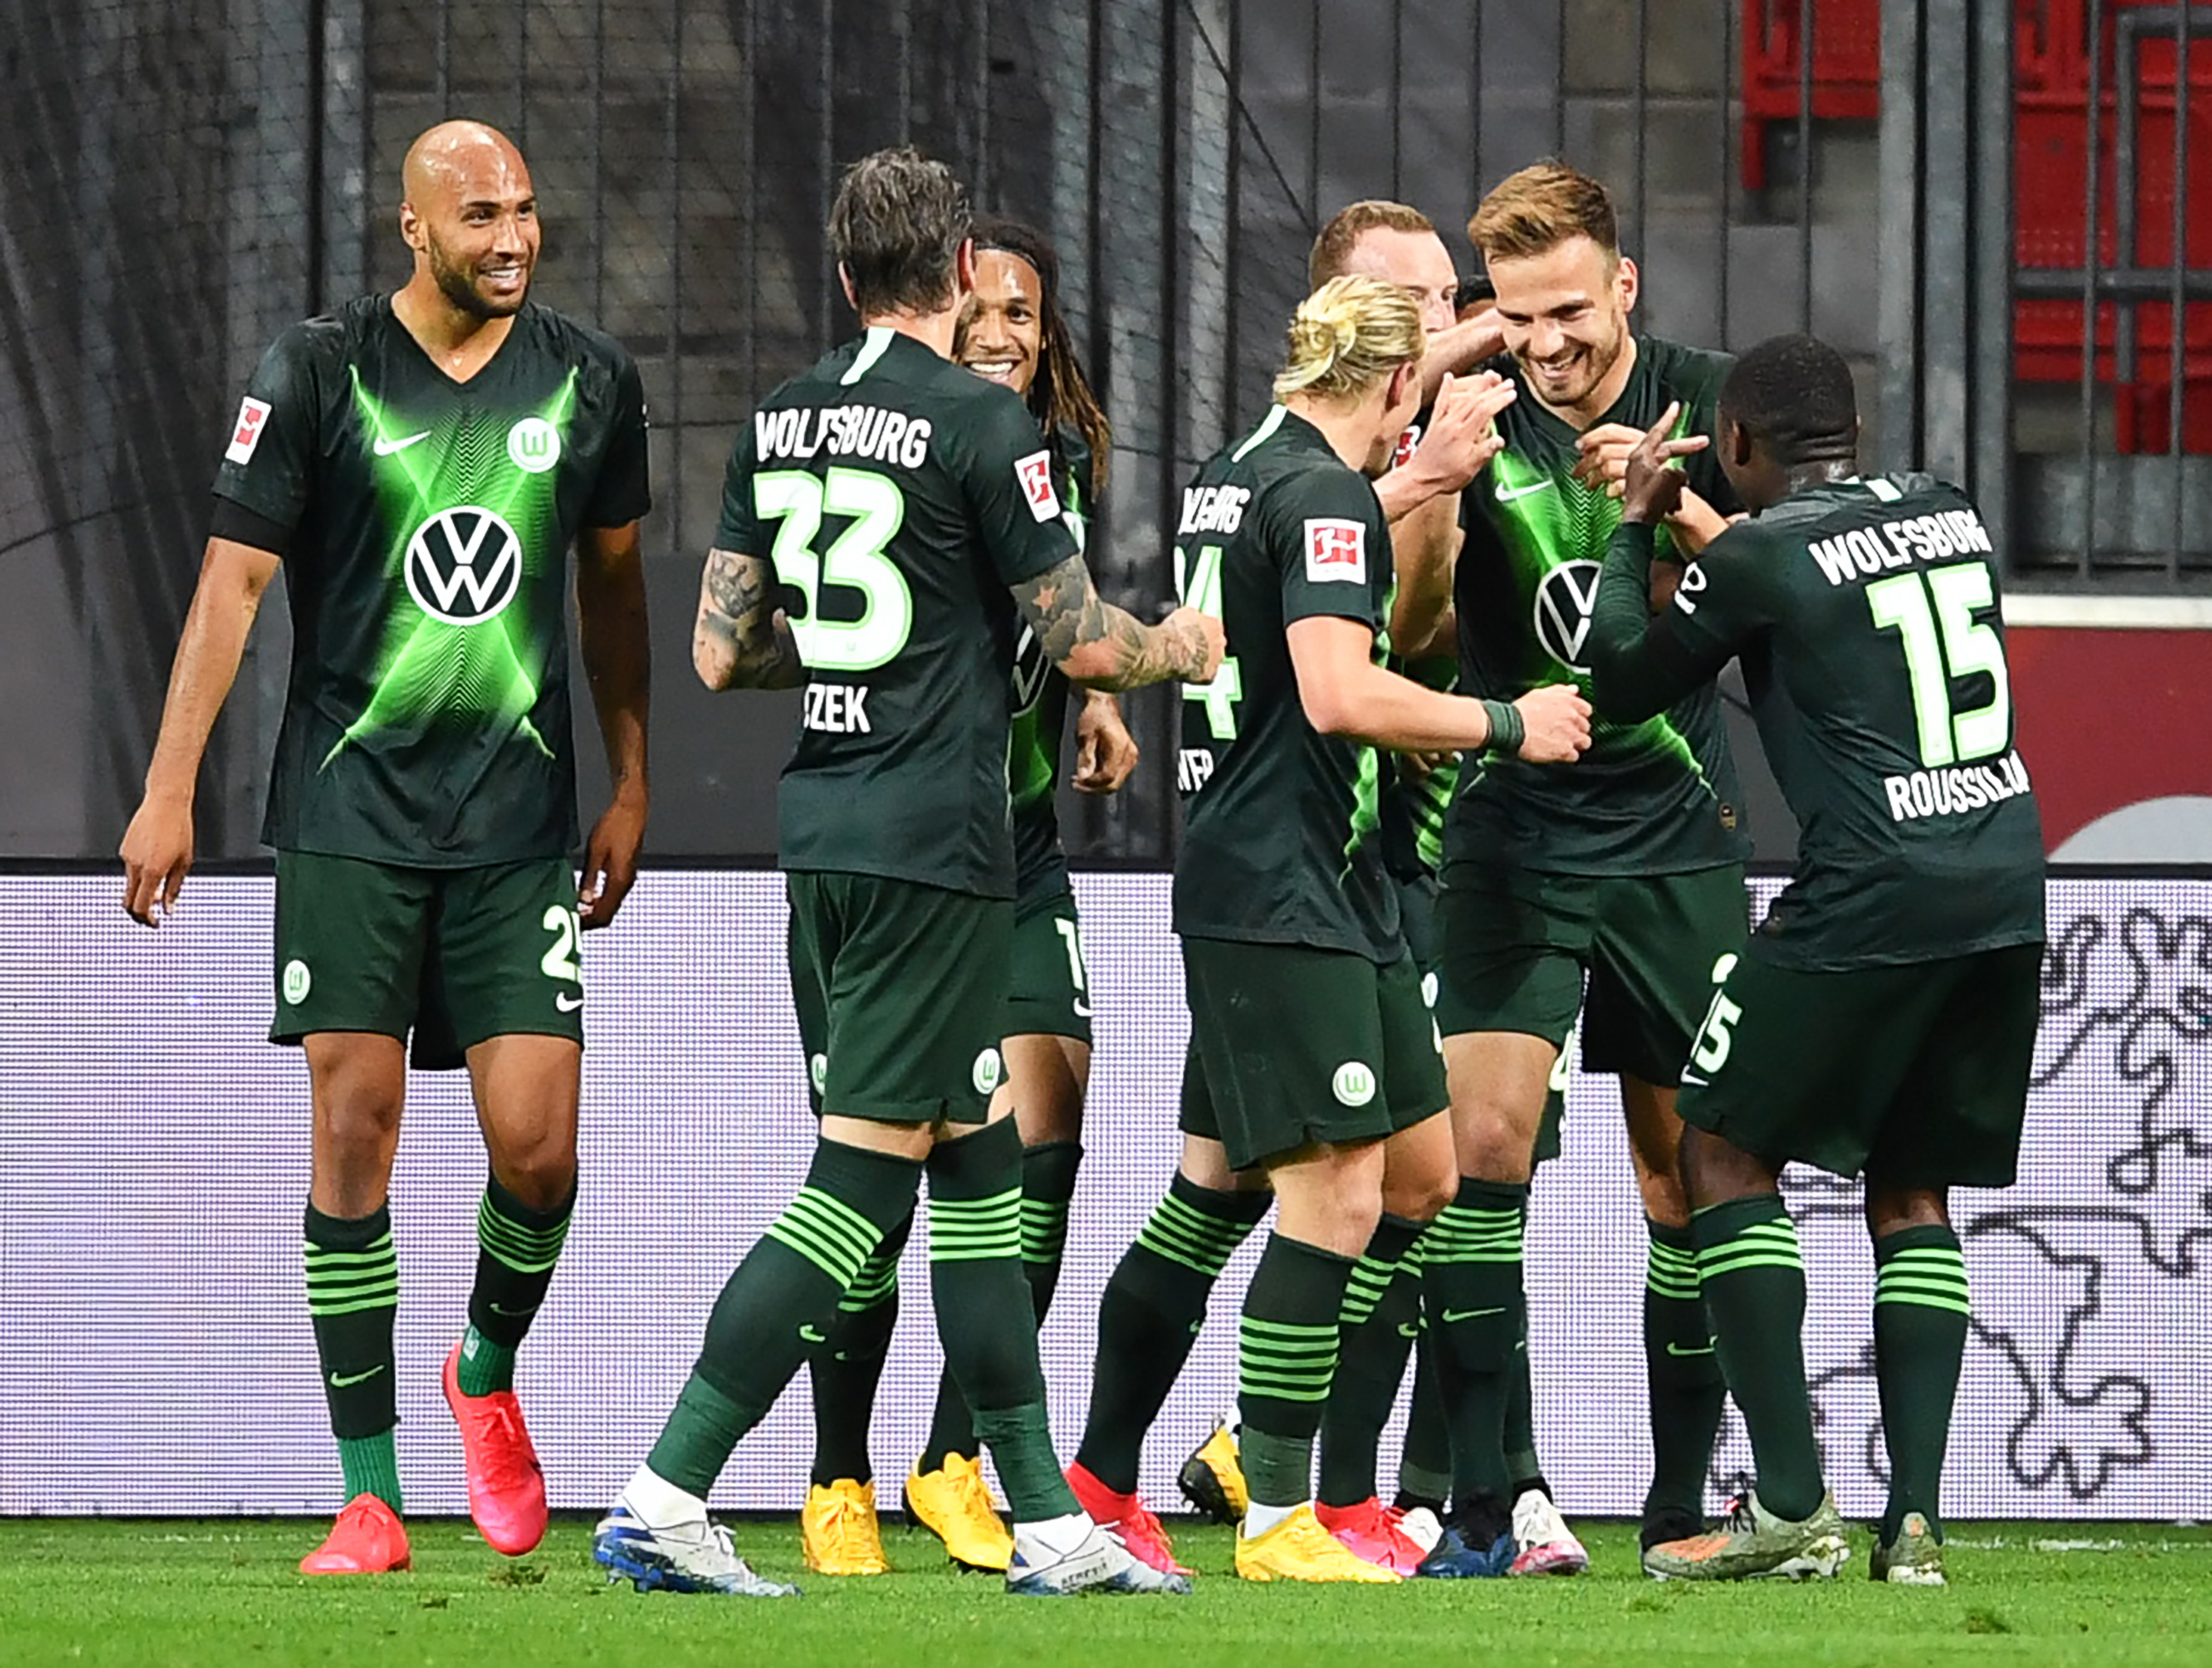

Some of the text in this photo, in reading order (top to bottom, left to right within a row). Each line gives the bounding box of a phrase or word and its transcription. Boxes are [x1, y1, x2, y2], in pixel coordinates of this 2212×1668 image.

[755, 405, 932, 468] WOLFSBURG
[753, 466, 914, 670] 33
[1867, 562, 2014, 767] 15
[804, 683, 871, 732] ZEK
[1690, 988, 1743, 1073] 5
